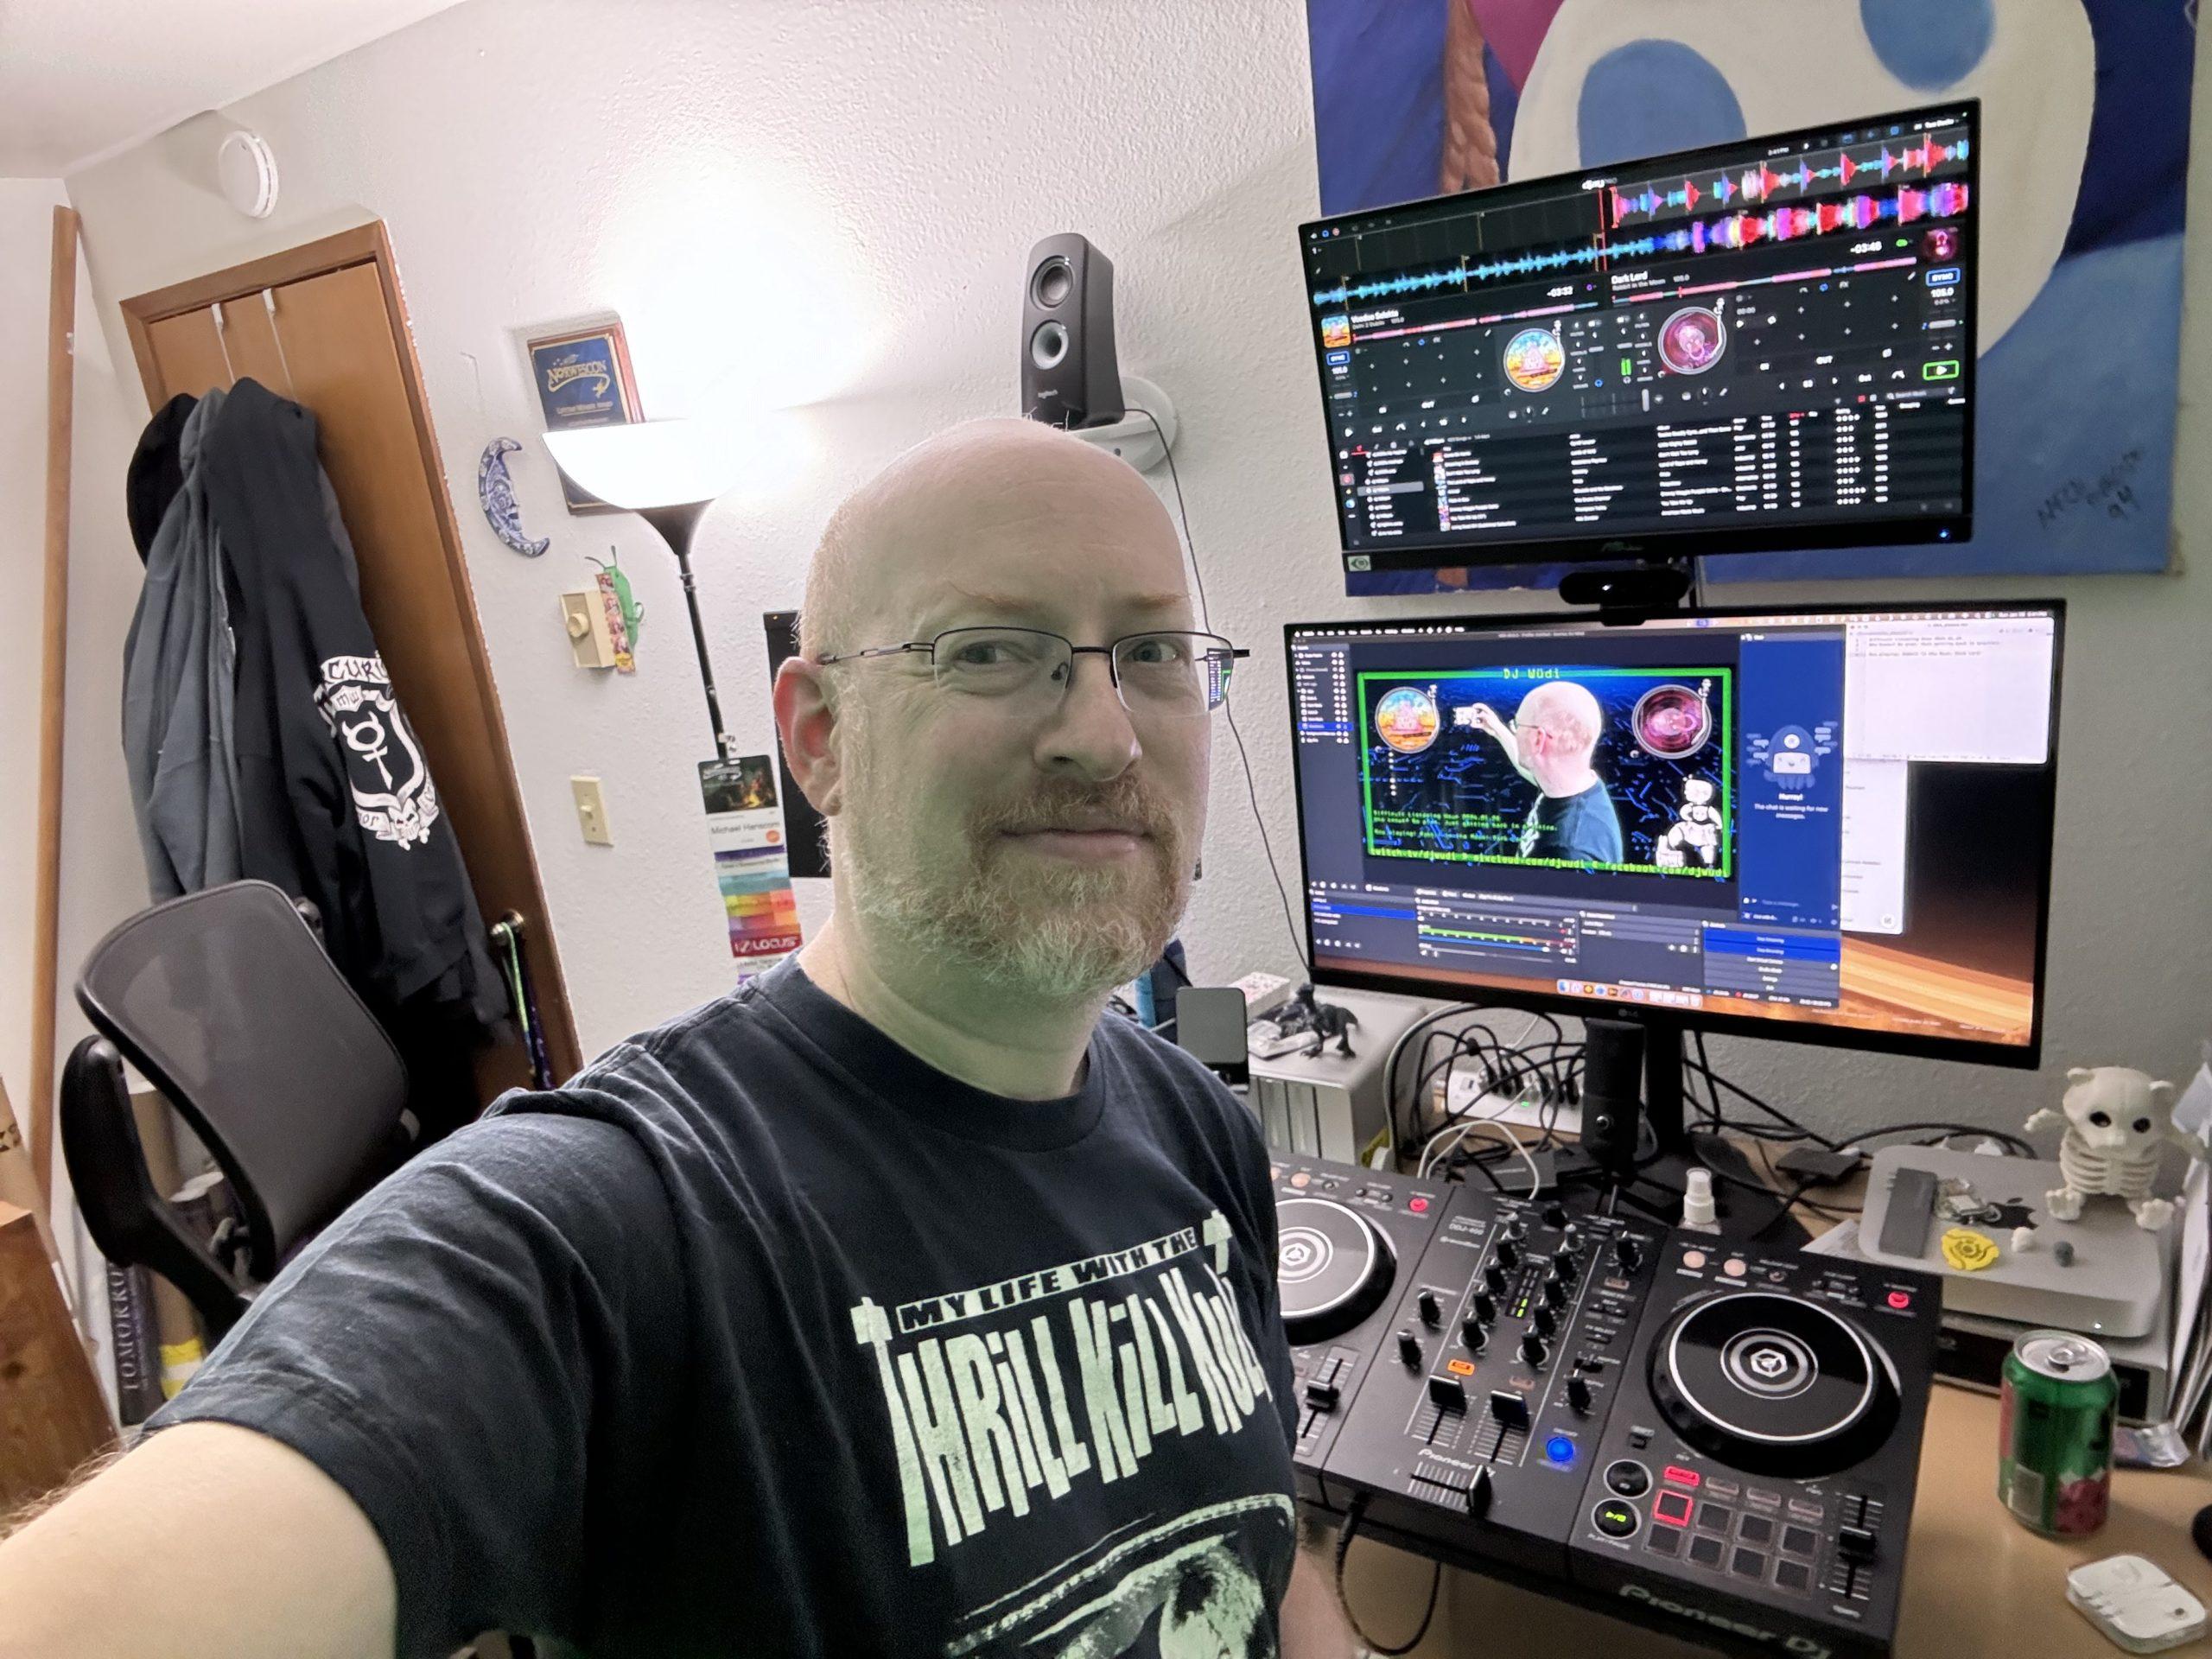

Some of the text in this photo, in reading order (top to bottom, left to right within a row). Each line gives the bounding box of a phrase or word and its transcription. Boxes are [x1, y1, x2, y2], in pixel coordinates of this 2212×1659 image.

[1503, 669, 1519, 679] DJ
[753, 936, 797, 951] LOCUS
[899, 1228, 1198, 1331] MY LIFE WITH THE
[1418, 1447, 1477, 1470] Pioneer
[1618, 1583, 1777, 1640] Pioneer
